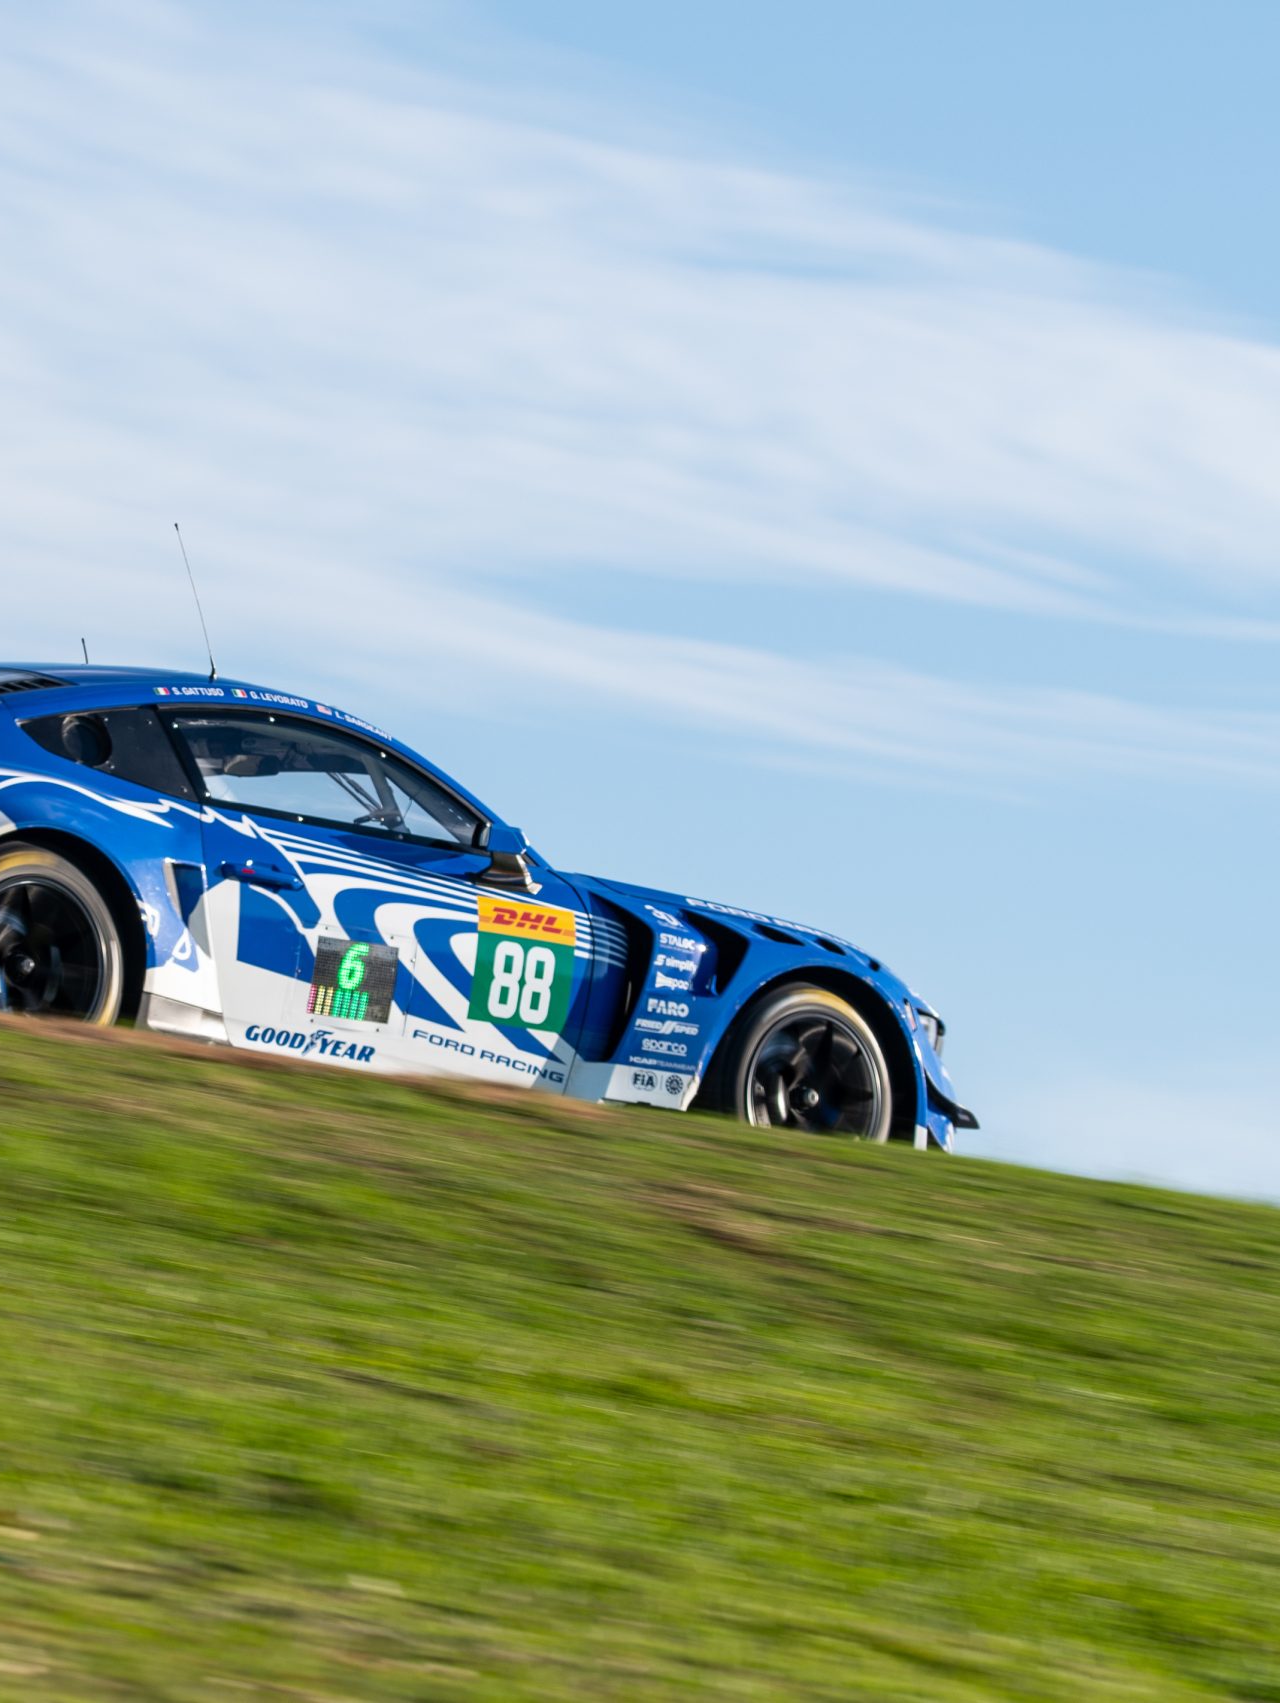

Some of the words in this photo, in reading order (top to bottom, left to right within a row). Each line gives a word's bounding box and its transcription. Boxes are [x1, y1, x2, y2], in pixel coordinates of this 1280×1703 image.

[260, 692, 308, 709] LEVORATO
[492, 906, 562, 934] DHL
[337, 942, 369, 990] 6
[487, 940, 556, 1025] 88
[646, 998, 690, 1018] FARO
[245, 1025, 376, 1063] GOODYEAR
[412, 1029, 476, 1056] FORD
[479, 1049, 566, 1083] RACING
[642, 1038, 688, 1054] sparco
